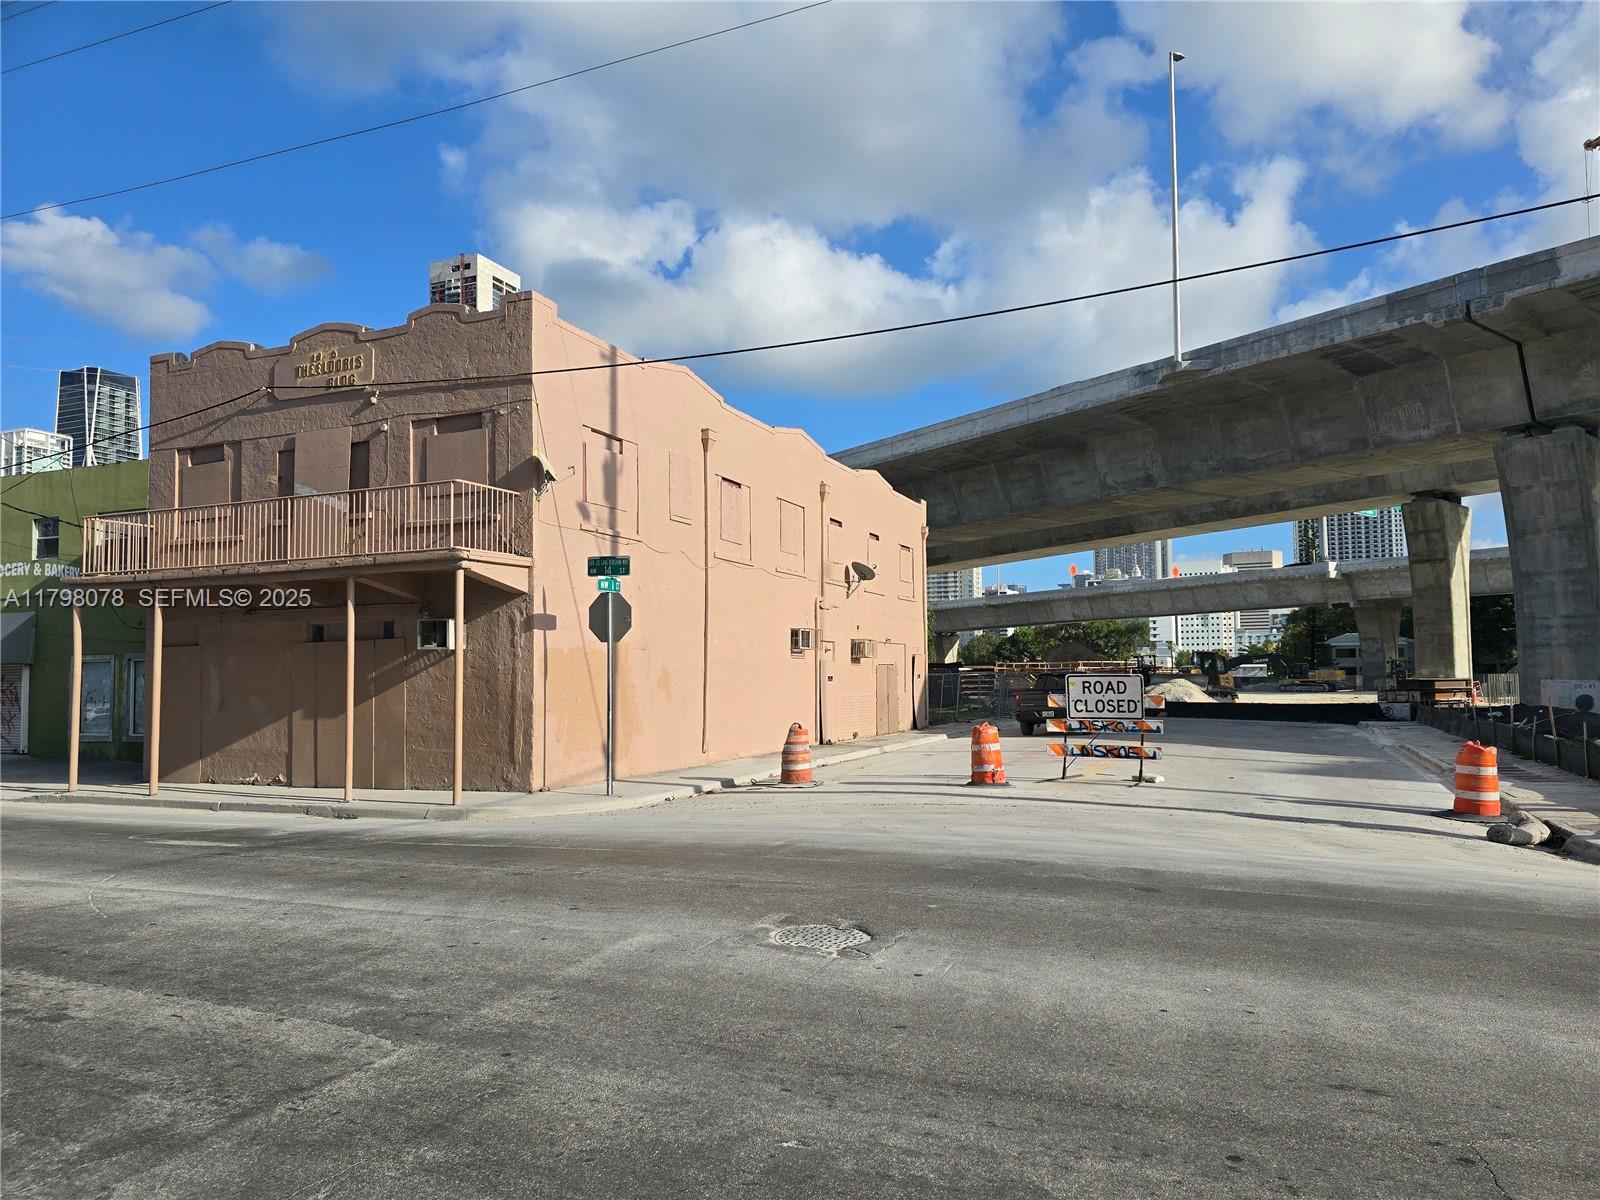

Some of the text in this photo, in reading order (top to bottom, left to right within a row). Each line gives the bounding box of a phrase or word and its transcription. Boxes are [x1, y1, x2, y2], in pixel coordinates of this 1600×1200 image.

[34, 562, 41, 576] &
[44, 563, 80, 578] BAKERY
[604, 565, 612, 575] 14
[600, 581, 609, 590] NW
[1082, 680, 1128, 695] ROAD
[1073, 699, 1138, 714] CLOSED
